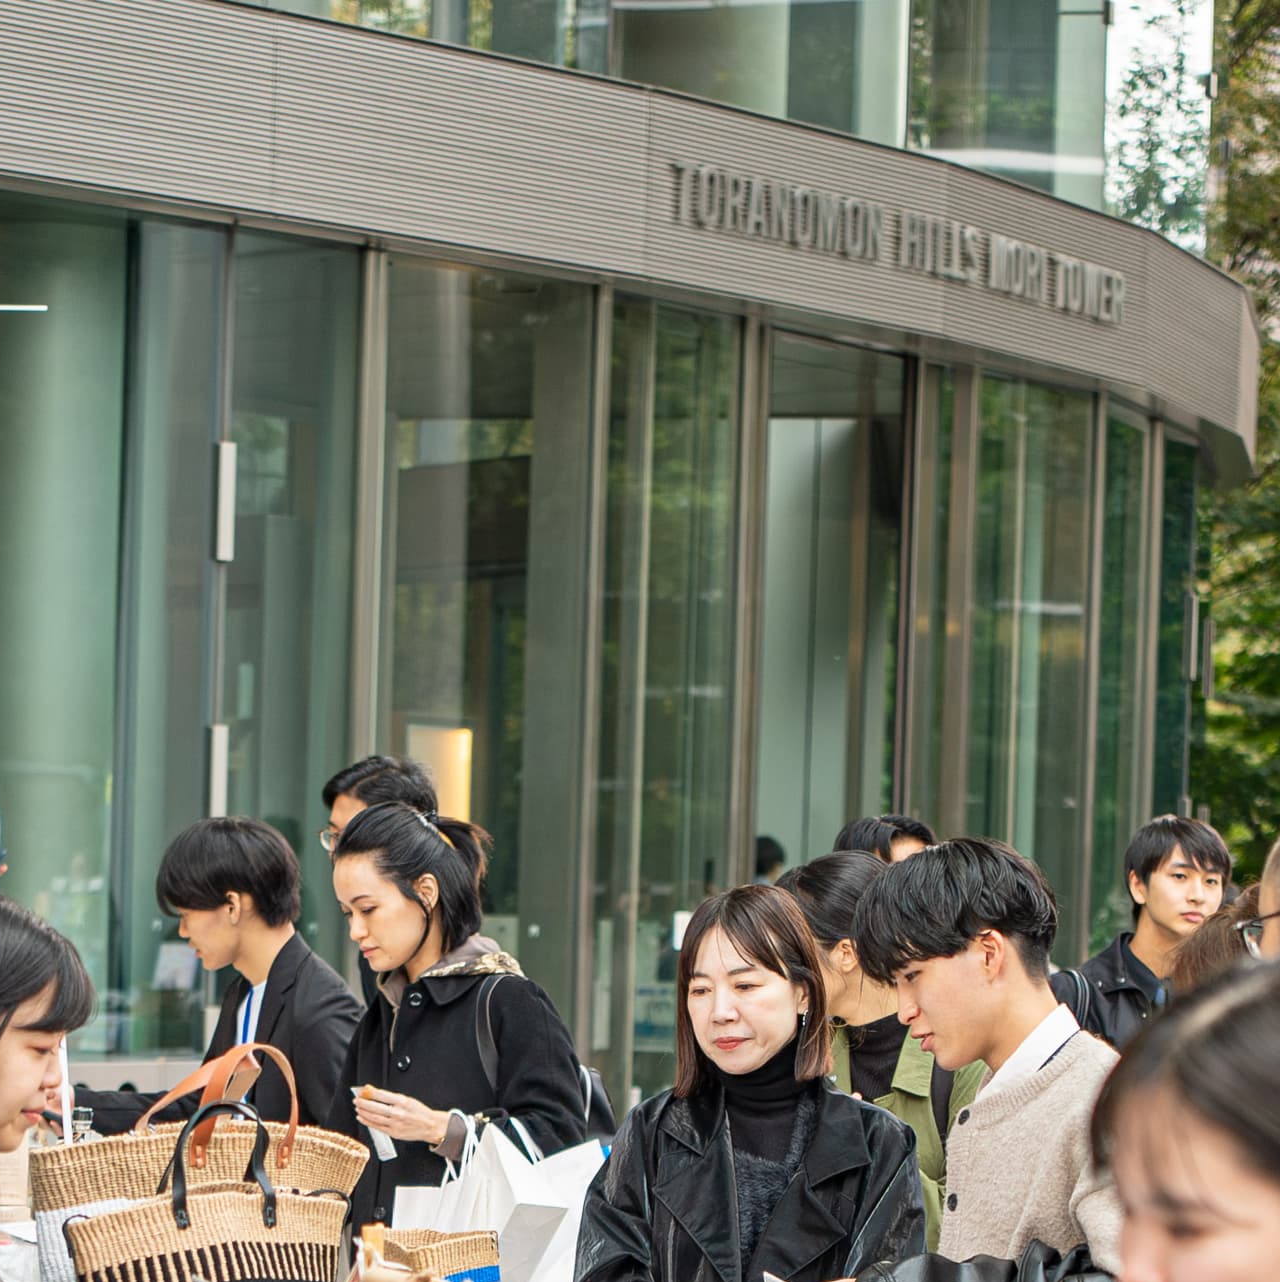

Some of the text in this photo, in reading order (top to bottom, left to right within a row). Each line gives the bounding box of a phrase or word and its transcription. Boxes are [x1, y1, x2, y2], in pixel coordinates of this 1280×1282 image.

[671, 162, 1126, 325] TORANOMON HILLS MORI TOWER
